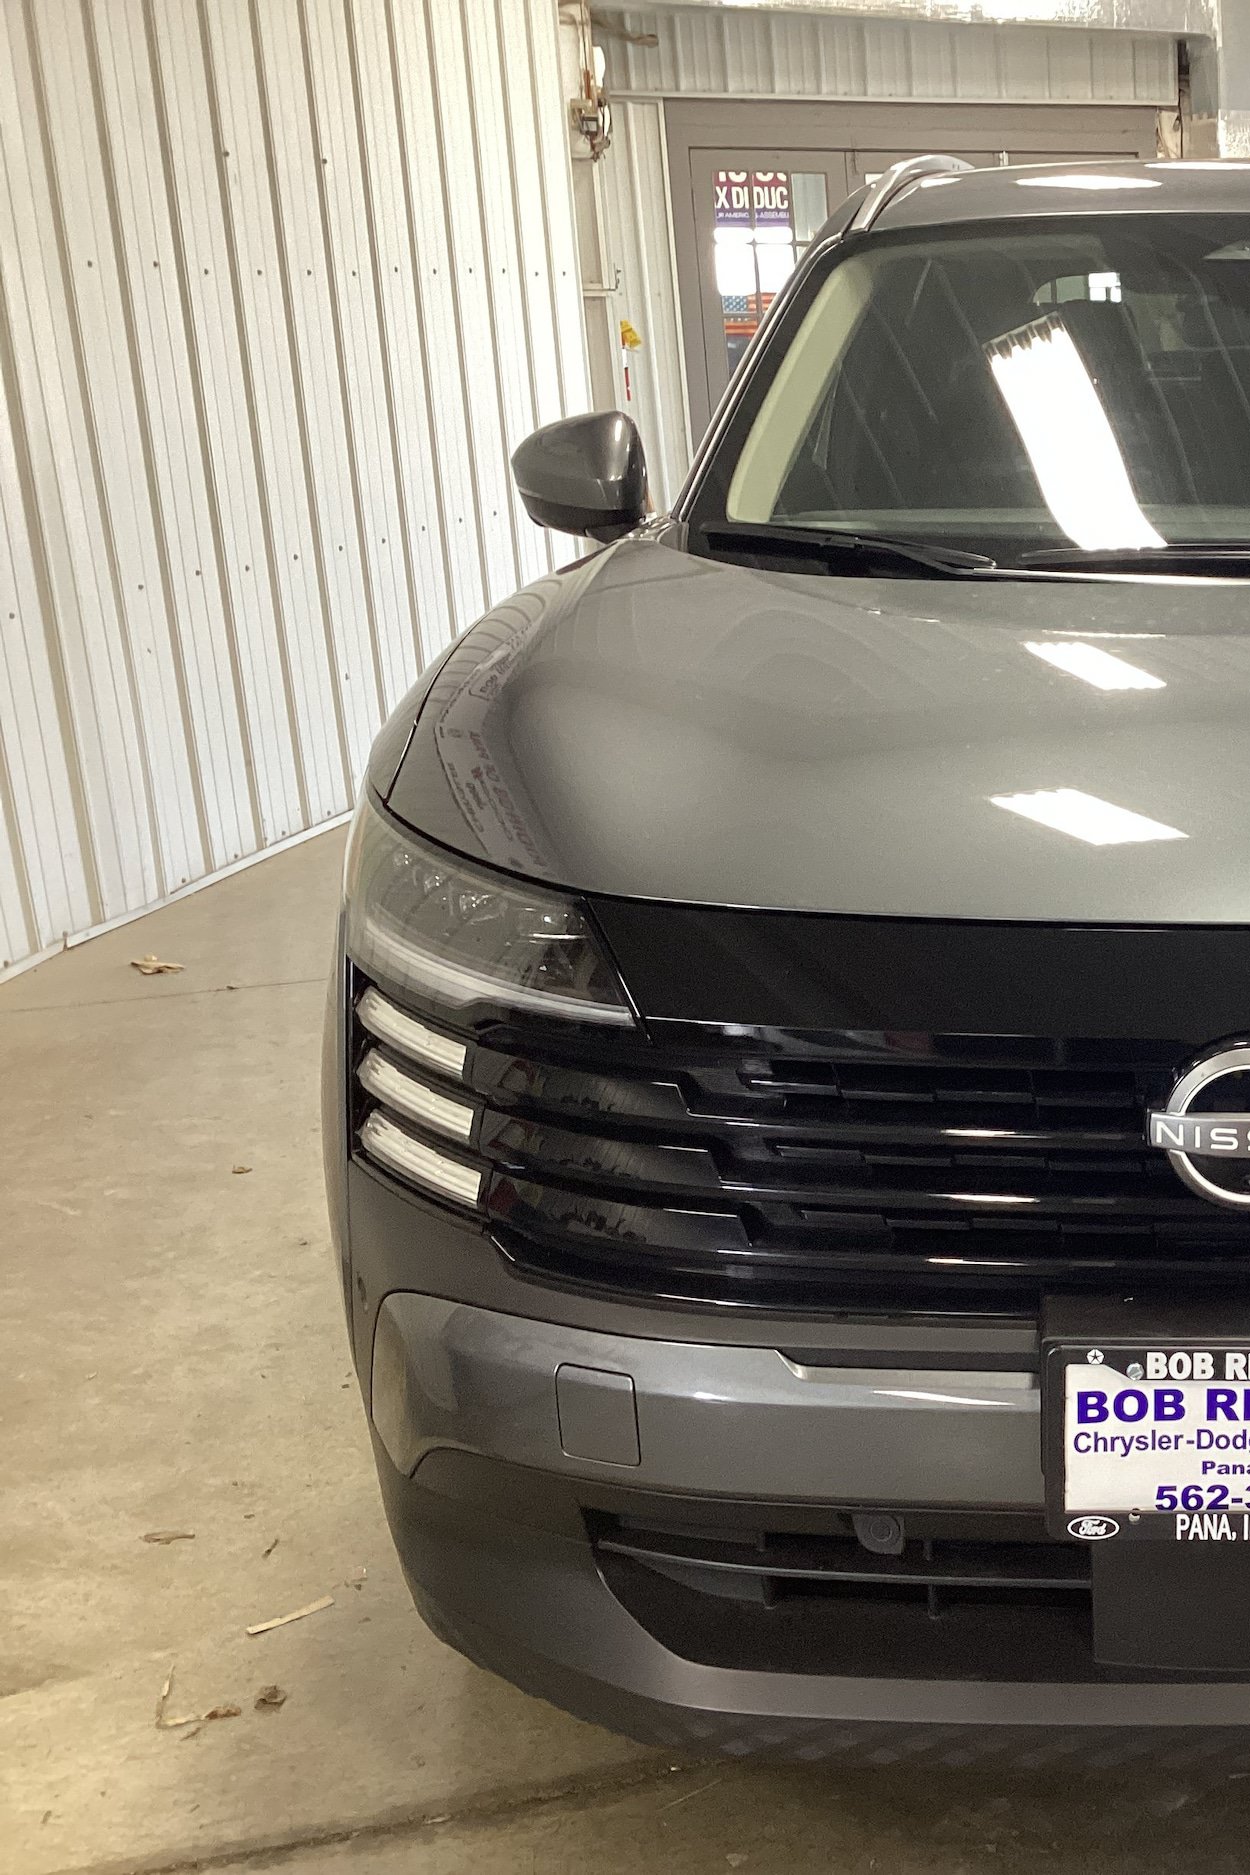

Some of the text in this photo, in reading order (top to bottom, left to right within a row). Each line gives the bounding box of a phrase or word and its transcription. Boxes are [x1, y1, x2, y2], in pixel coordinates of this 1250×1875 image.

[1146, 1351, 1215, 1380] BOB
[1077, 1388, 1186, 1424] BOB
[1078, 1519, 1107, 1536] Ford
[1175, 1513, 1237, 1542] PANA,
